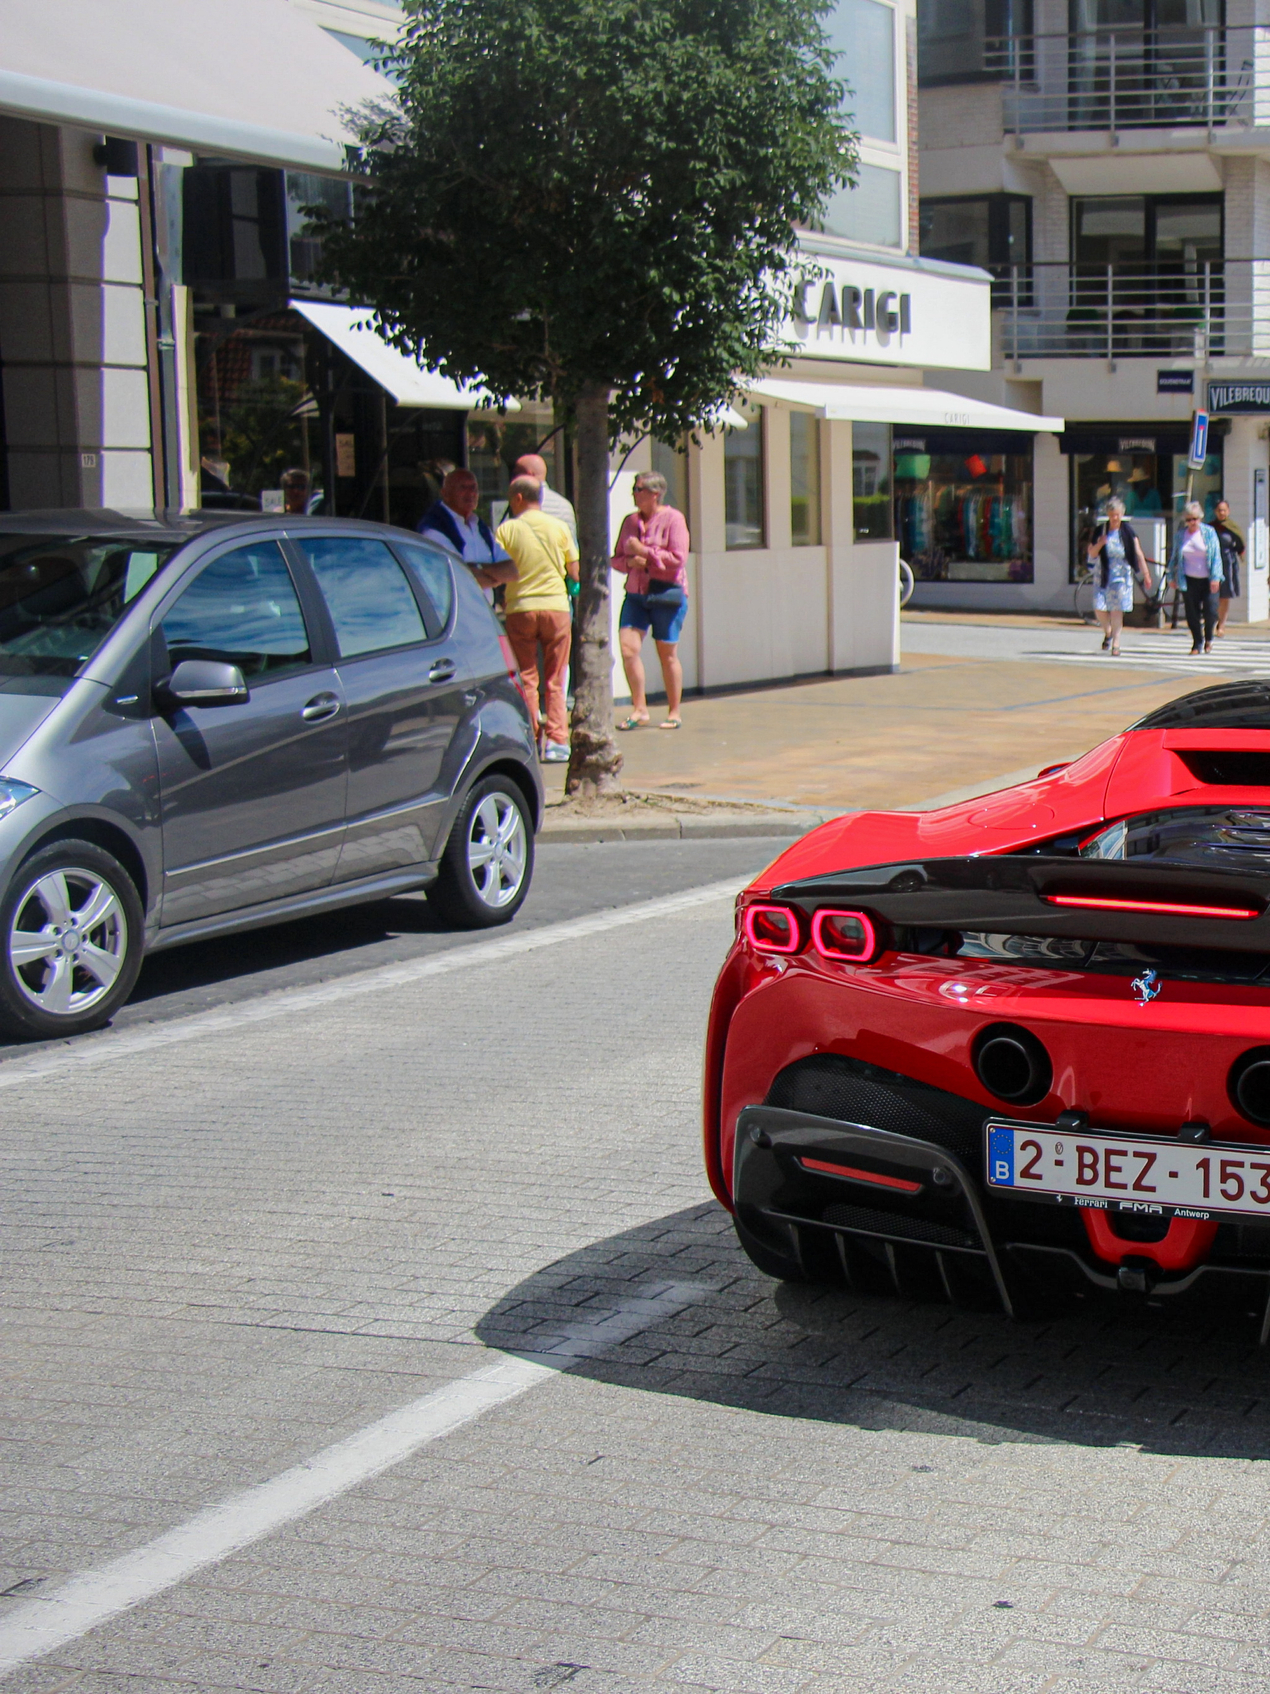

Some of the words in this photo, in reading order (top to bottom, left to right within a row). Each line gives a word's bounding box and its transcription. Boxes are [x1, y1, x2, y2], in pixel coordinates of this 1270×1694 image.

[793, 279, 911, 334] CARIGI
[995, 1161, 1009, 1180] B
[1074, 1197, 1108, 1209] Ferrari
[1119, 1201, 1163, 1215] FMA
[1174, 1208, 1210, 1220] Antwerp
